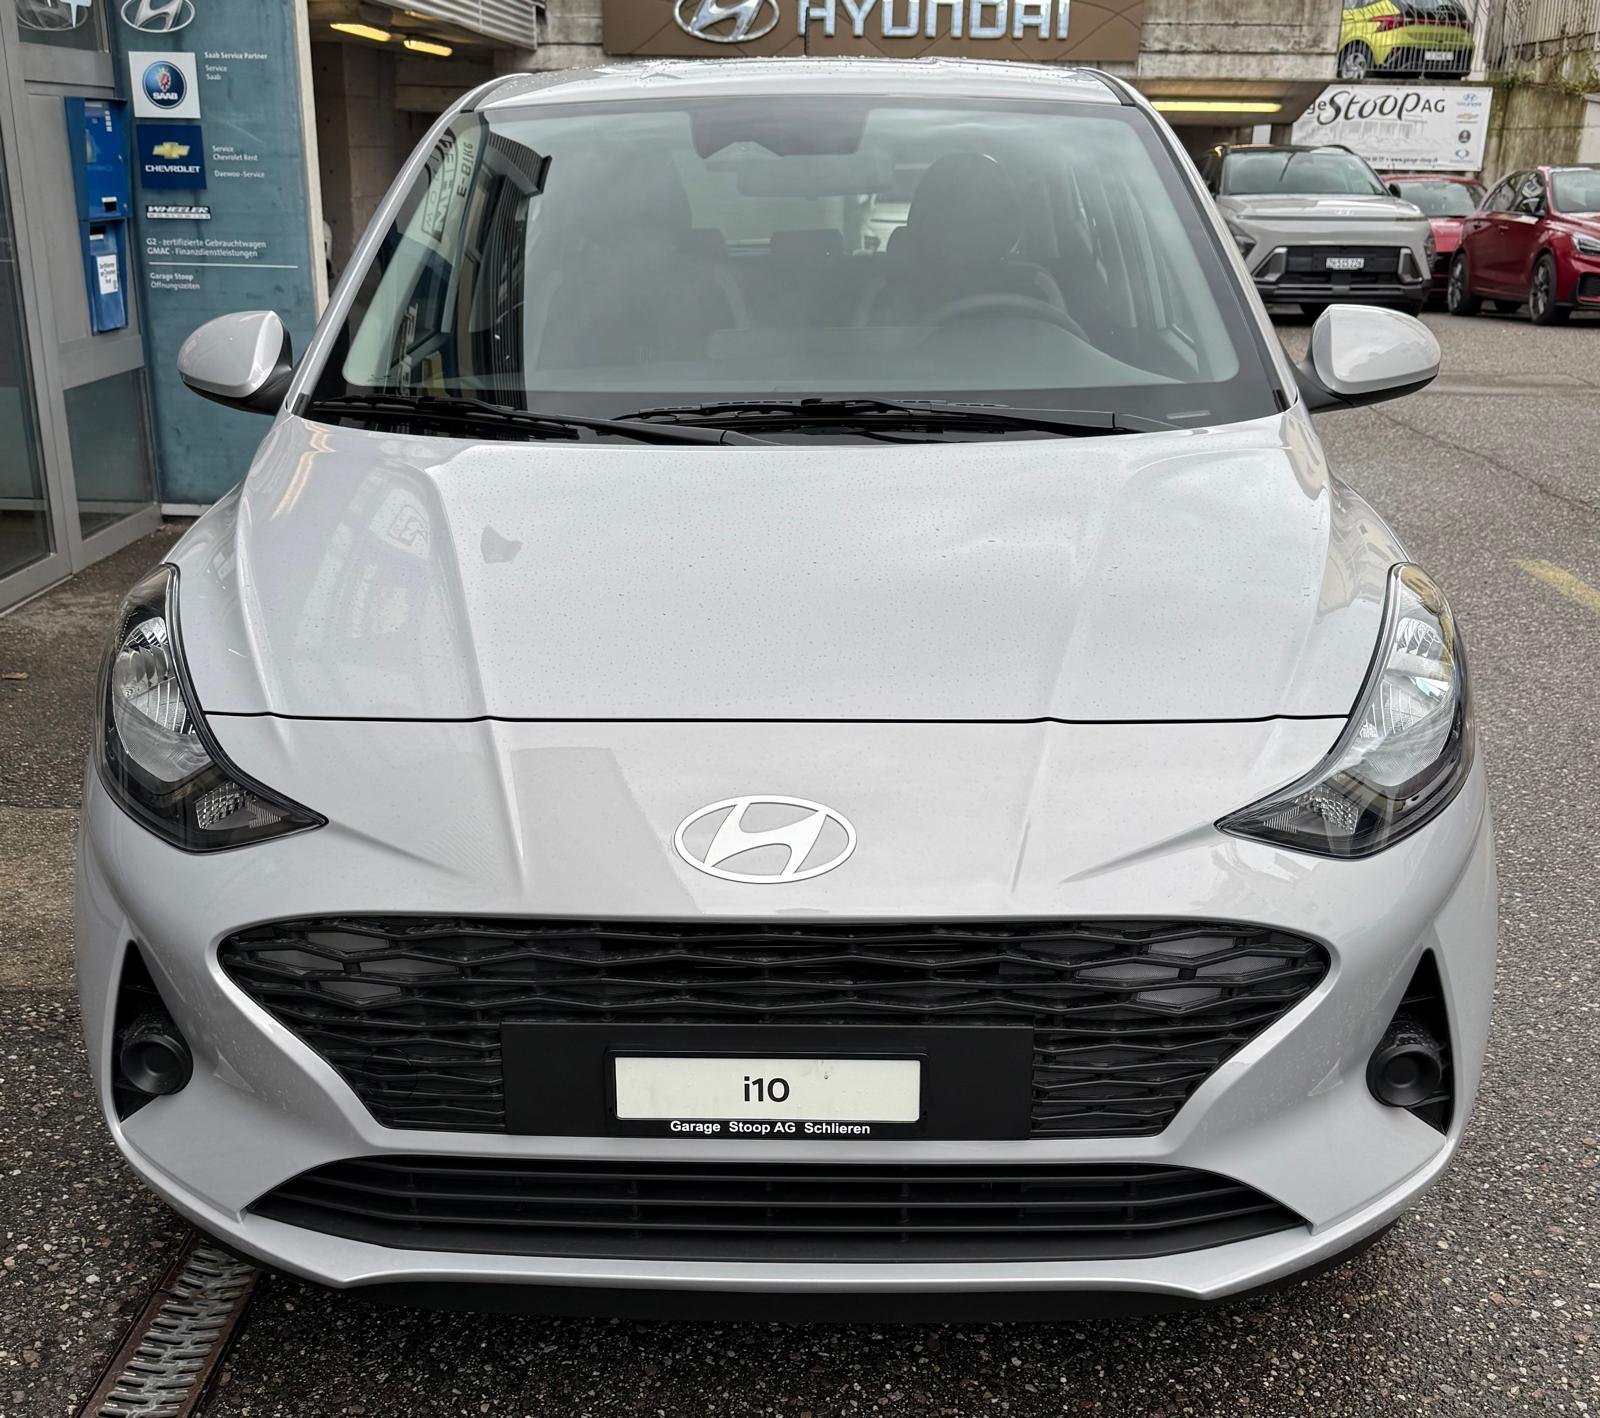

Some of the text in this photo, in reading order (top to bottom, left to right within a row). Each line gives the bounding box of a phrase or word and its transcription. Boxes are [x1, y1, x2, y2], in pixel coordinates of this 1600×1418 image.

[798, 0, 1070, 39] HYUNDAI
[204, 51, 268, 60] Saab Service Partner
[205, 64, 227, 72] Service
[152, 91, 178, 100] SAAB
[1421, 98, 1446, 113] AG
[212, 145, 234, 153] Service
[213, 153, 243, 161] Chevrolet
[145, 164, 201, 173] CHEVROLET
[214, 169, 265, 178] Daewoo-Service
[148, 205, 209, 213] WHEELER
[146, 238, 157, 246] G2
[162, 238, 204, 247] zertifizierte
[205, 239, 267, 250] Gebrauchtwagen
[147, 247, 170, 255] GMAC
[175, 248, 258, 259] Finanzdienstleistungen
[150, 272, 194, 282] Garage Stoop
[743, 1076, 790, 1103] i10
[670, 1121, 870, 1135] Garage Stoop AG Schlieren
